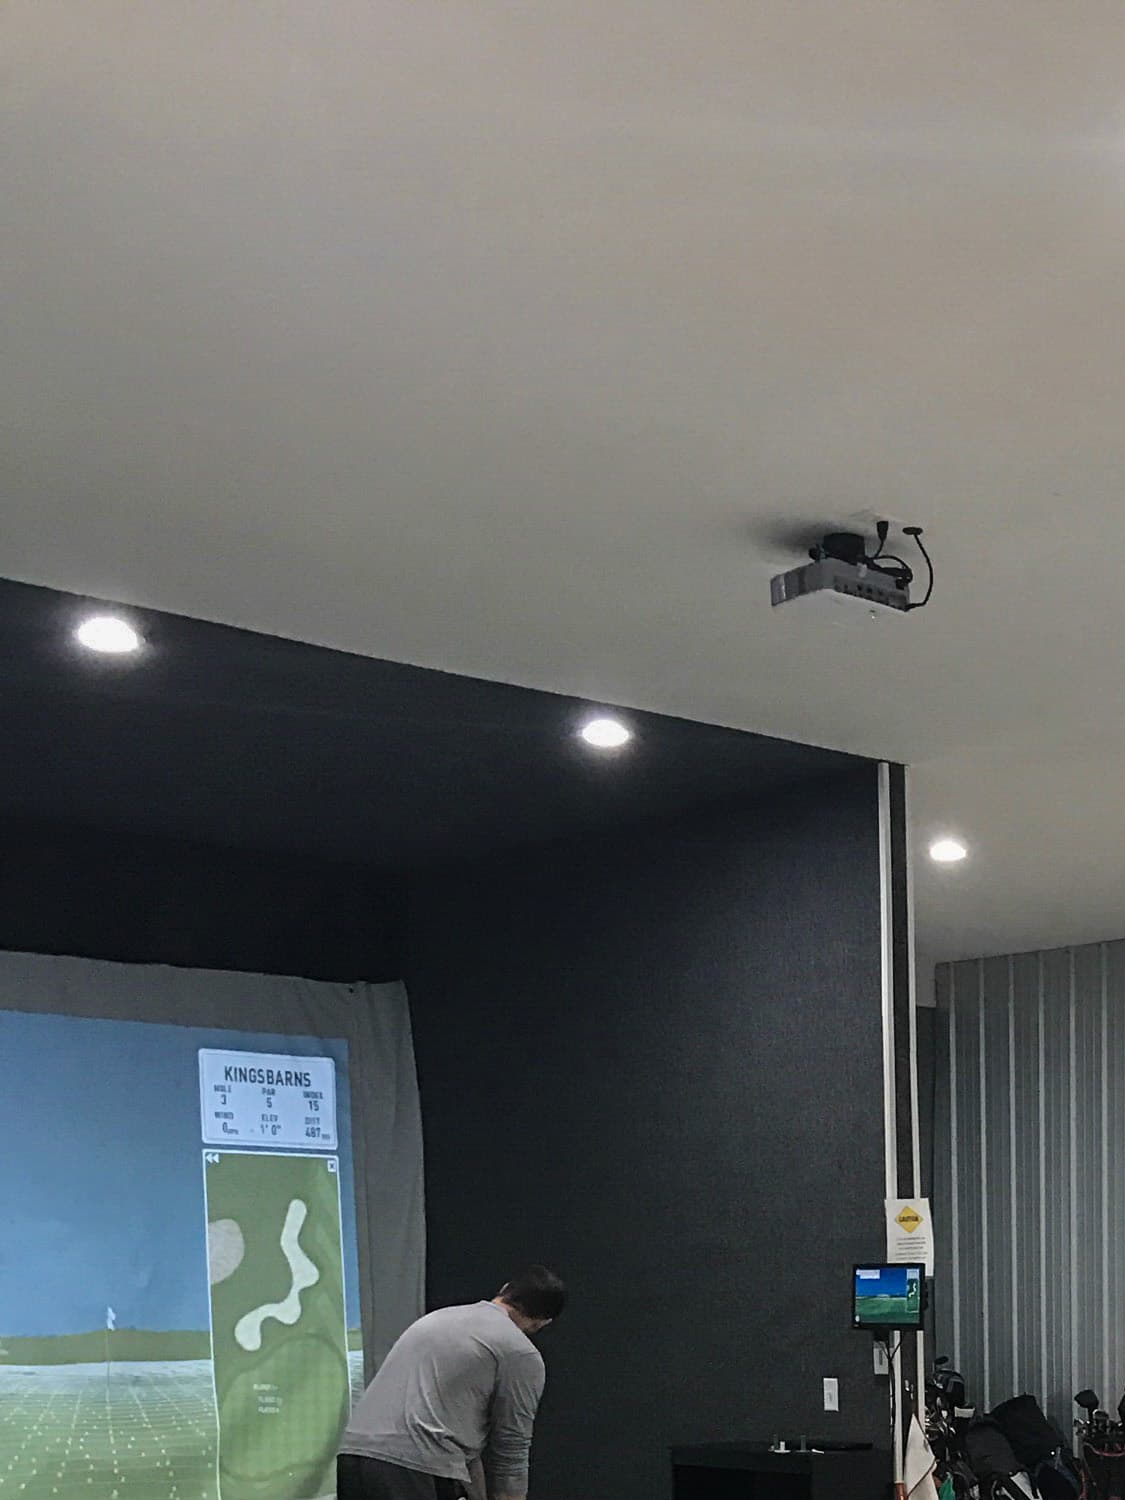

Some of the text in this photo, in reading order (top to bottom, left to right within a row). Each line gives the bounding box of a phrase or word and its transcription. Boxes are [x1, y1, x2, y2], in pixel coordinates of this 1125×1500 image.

[224, 1065, 311, 1088] KINGSBARNS
[262, 1087, 276, 1096] PAR
[221, 1094, 227, 1105] 3
[266, 1097, 272, 1108] 5
[308, 1100, 320, 1111] 15
[305, 1126, 321, 1138] 487
